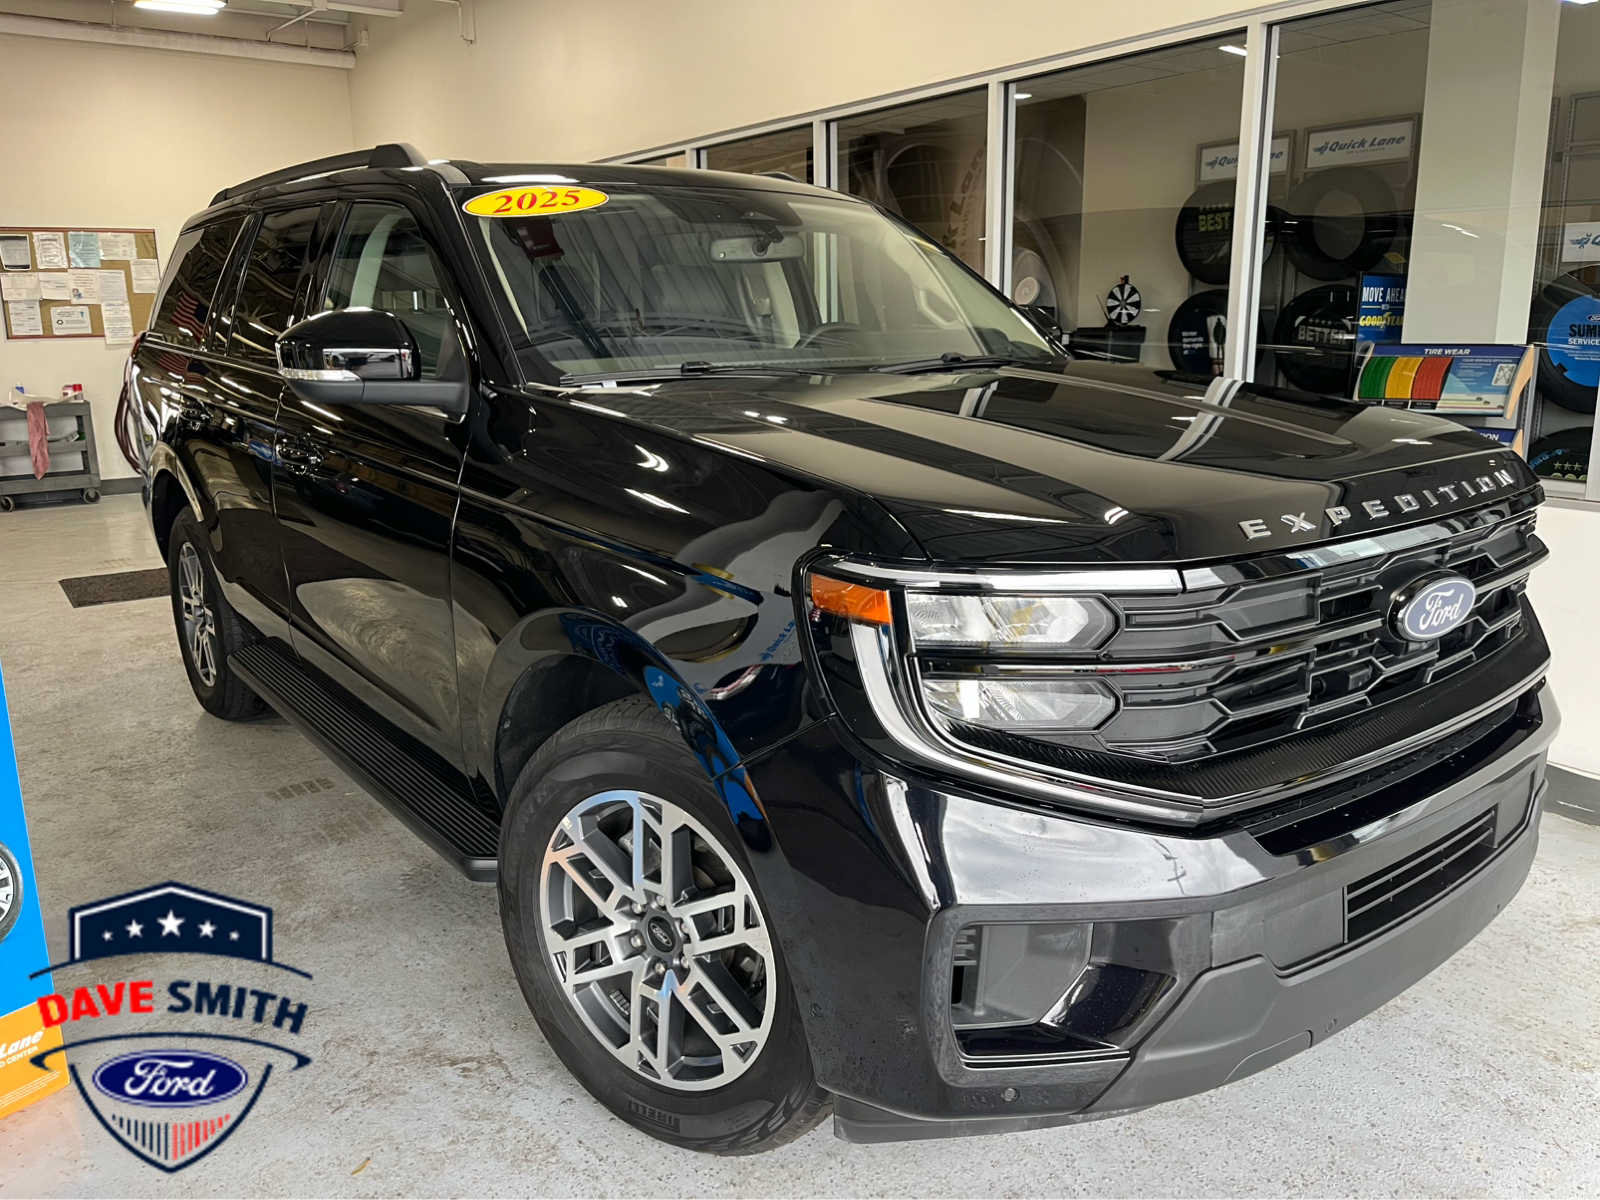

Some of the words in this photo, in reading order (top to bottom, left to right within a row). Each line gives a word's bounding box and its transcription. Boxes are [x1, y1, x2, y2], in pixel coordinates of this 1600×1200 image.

[1329, 138, 1367, 152] Quick
[1369, 135, 1406, 148] Lane
[493, 190, 581, 214] 2025
[1198, 212, 1231, 232] BEST
[1362, 286, 1384, 303] MOVE
[1386, 287, 1406, 303] AHEA
[1298, 325, 1347, 344] BETTER
[1237, 468, 1516, 541] EXPEDITION
[1418, 588, 1465, 631] Ford
